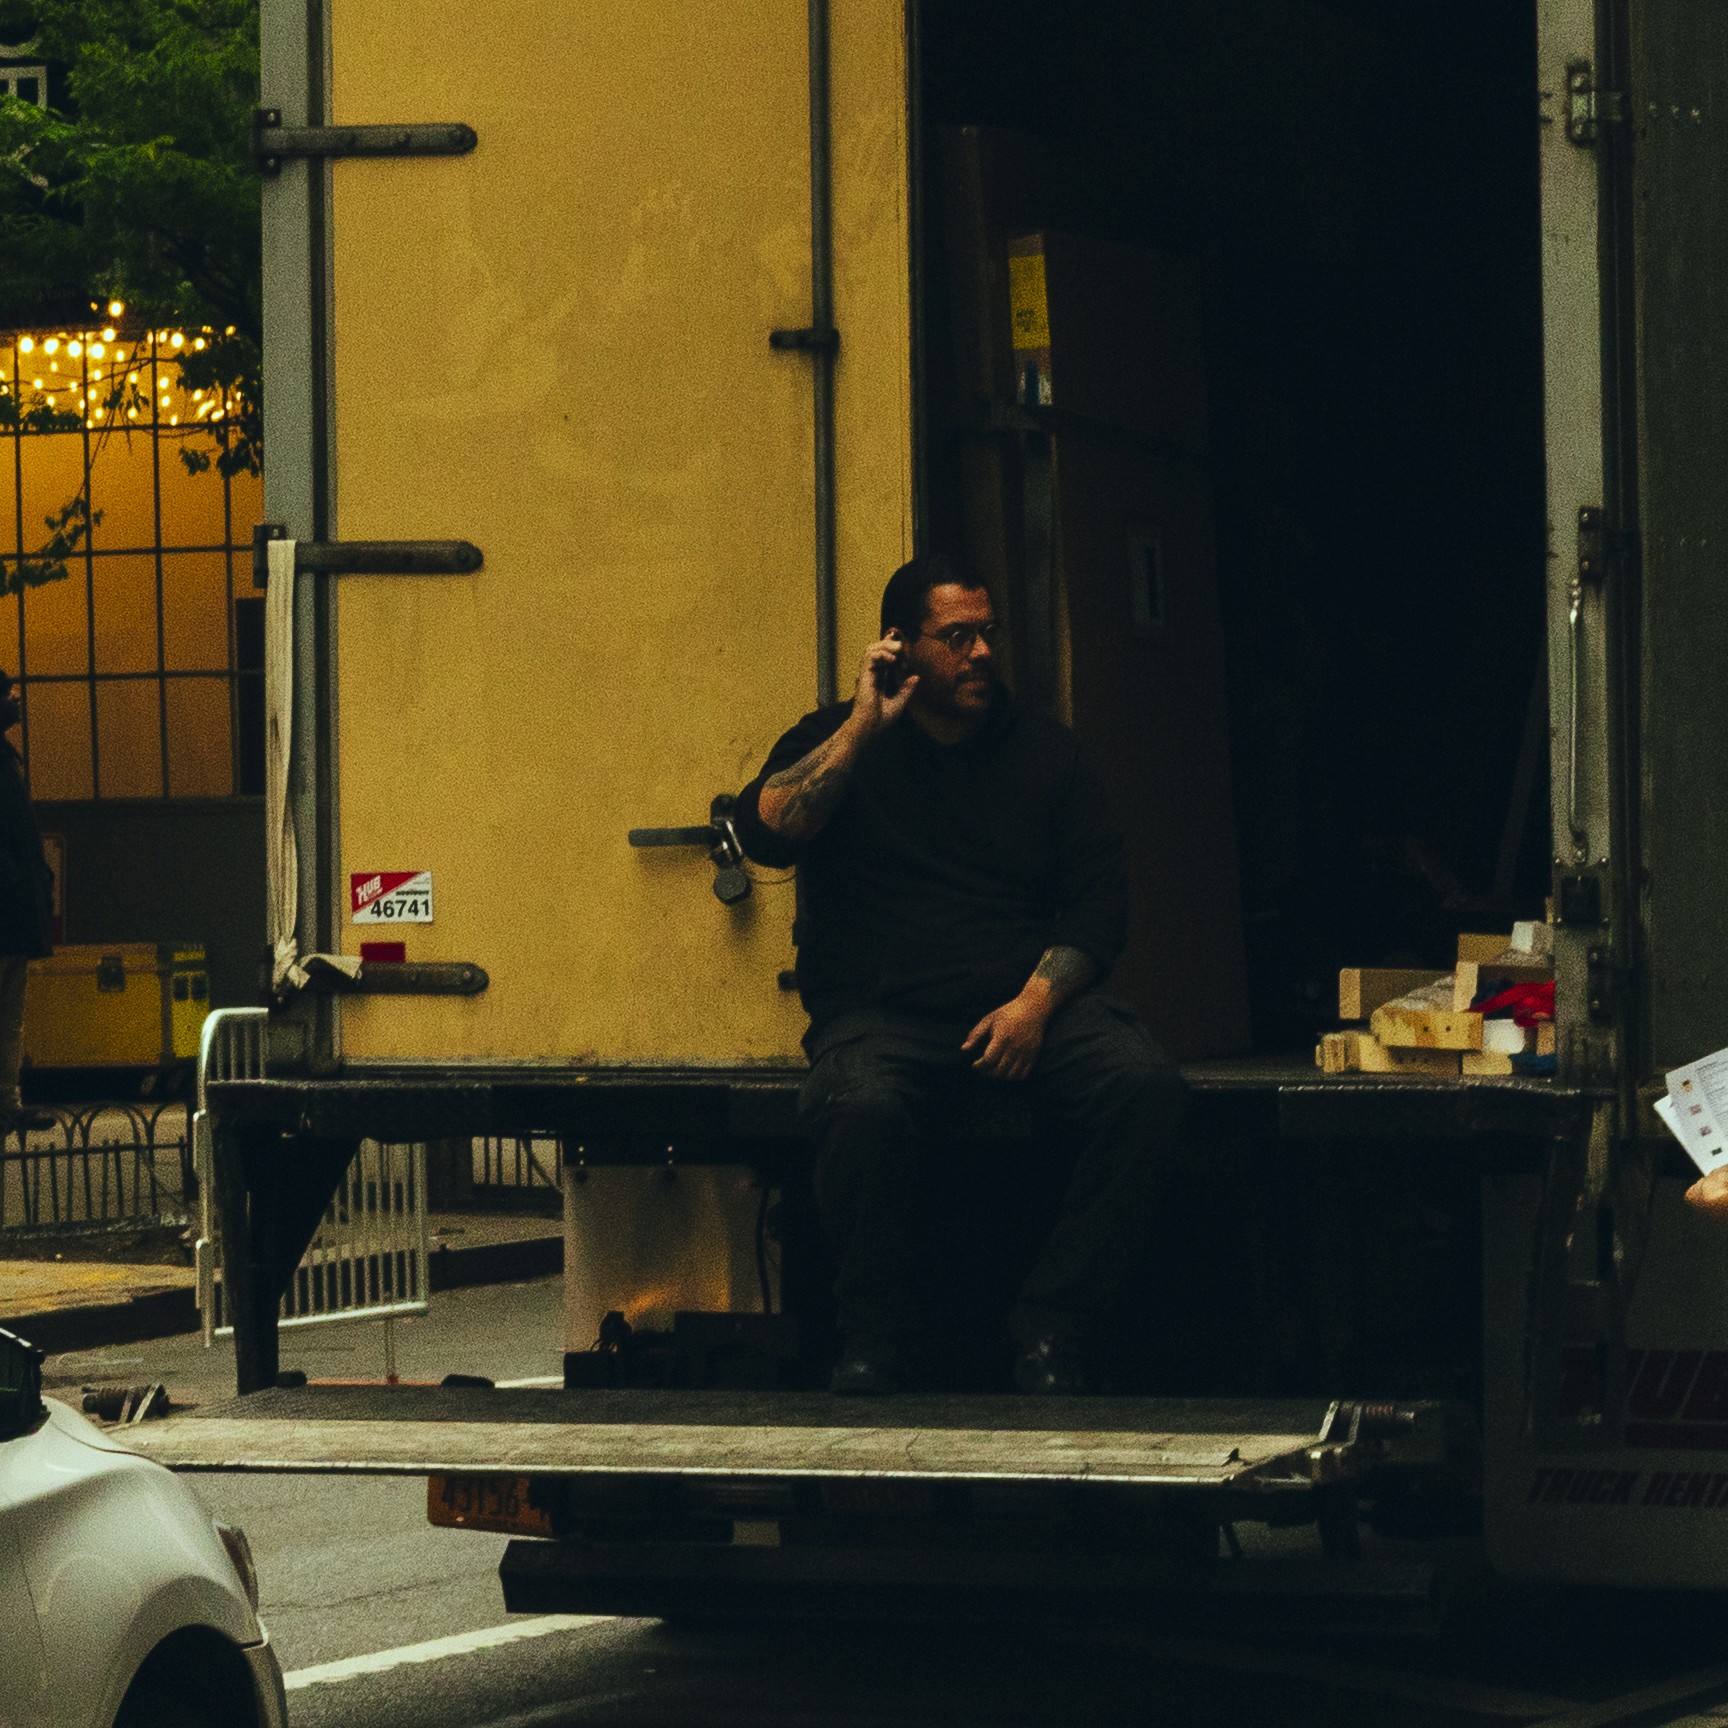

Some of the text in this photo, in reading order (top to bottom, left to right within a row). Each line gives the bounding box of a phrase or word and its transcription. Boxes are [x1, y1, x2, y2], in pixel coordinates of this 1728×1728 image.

[370, 898, 431, 919] 46741
[1527, 1467, 1728, 1508] TRUCK RENT
